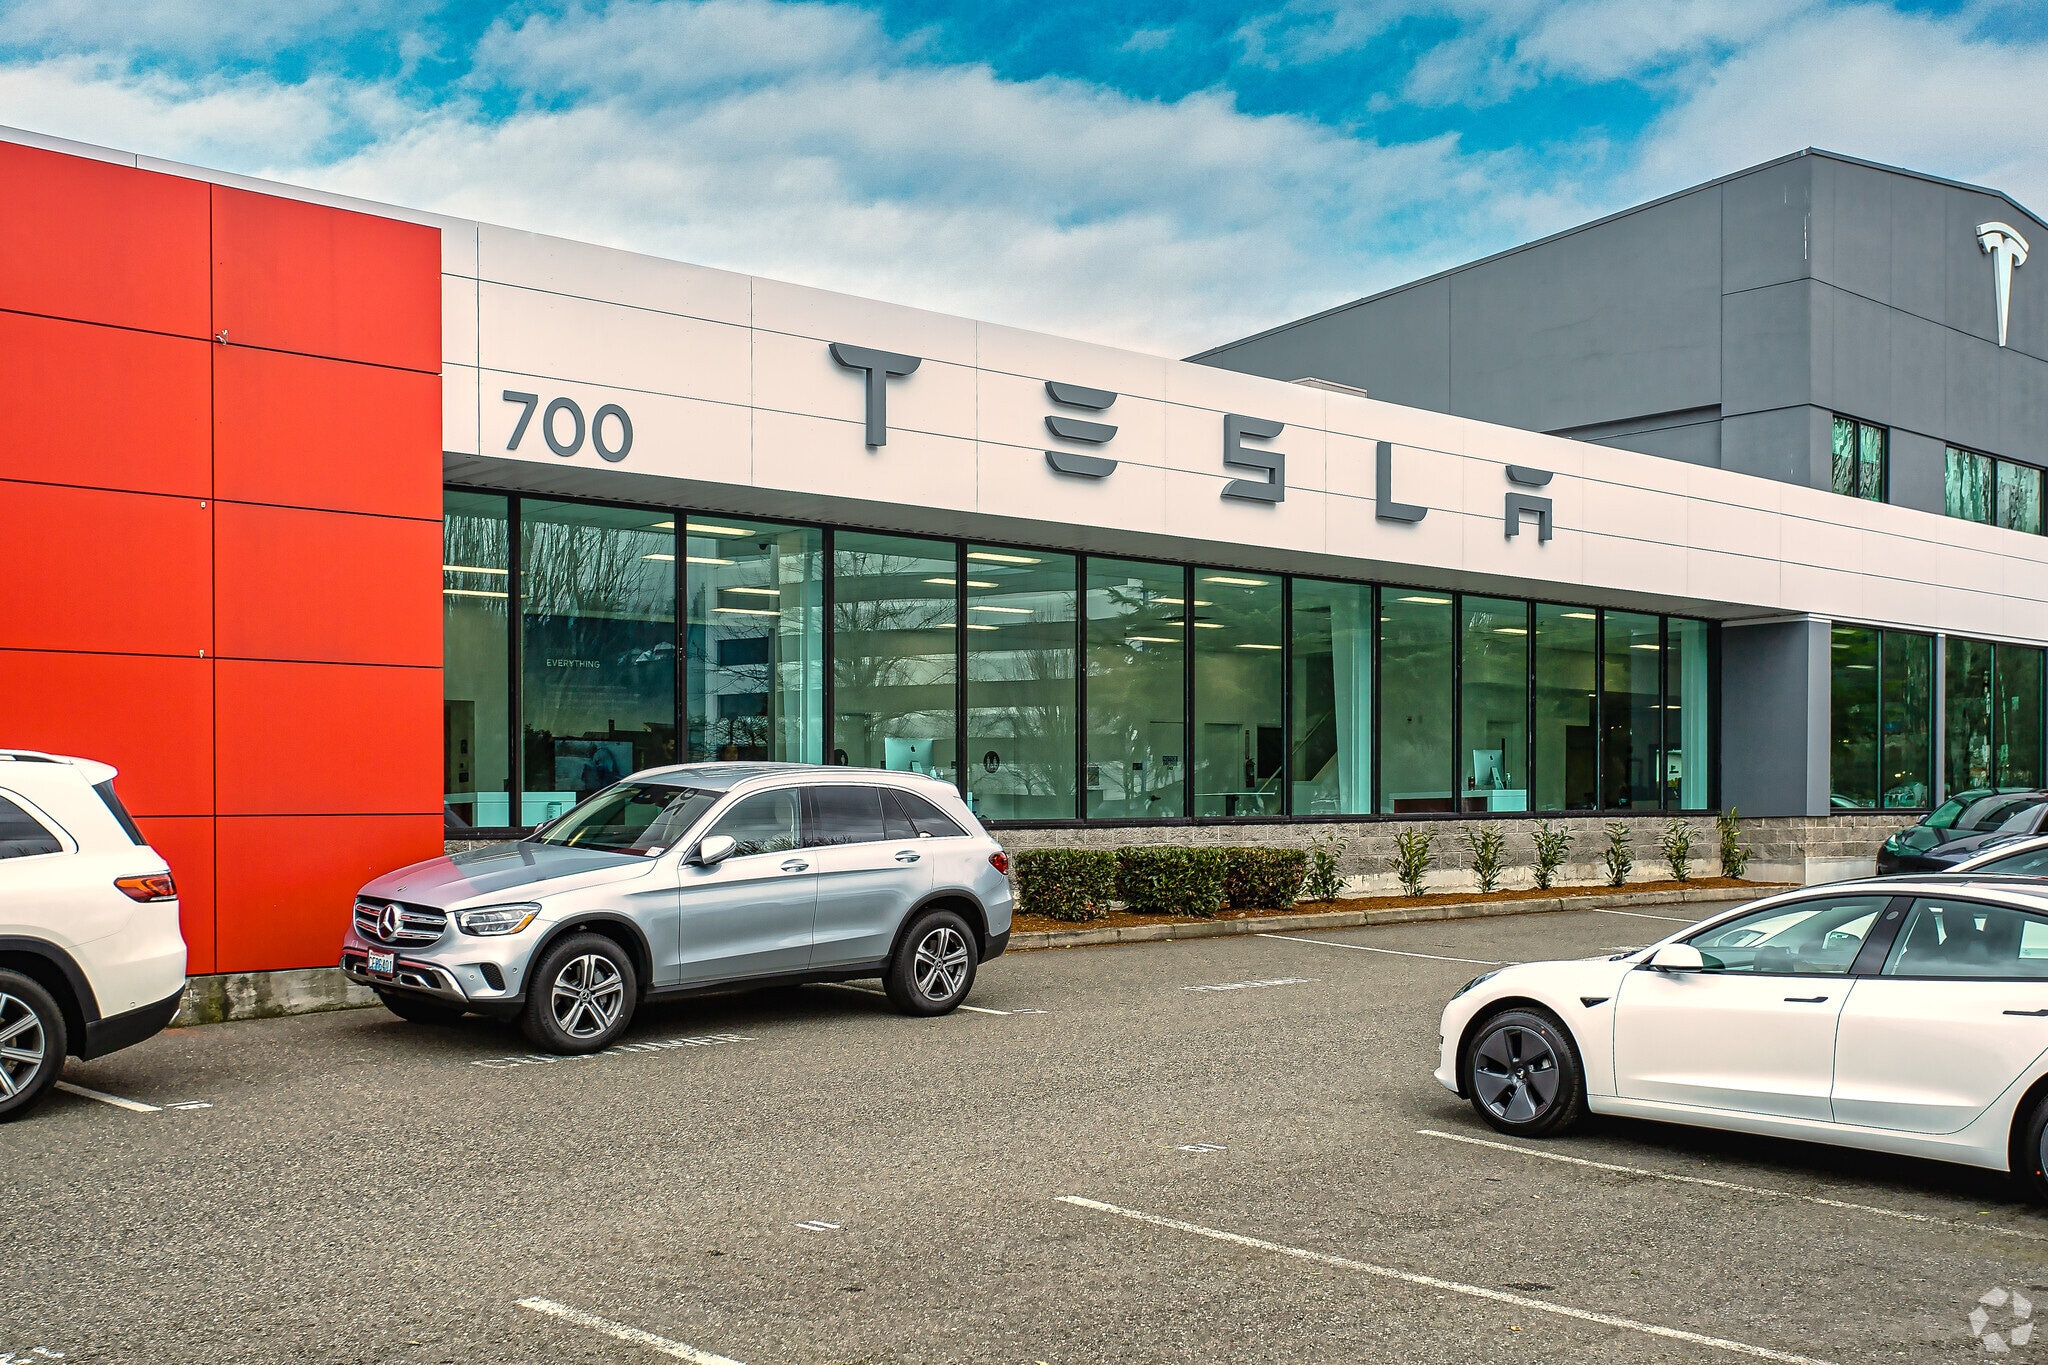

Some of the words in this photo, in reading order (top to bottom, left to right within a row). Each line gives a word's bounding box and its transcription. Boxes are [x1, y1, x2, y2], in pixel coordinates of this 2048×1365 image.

[502, 389, 634, 463] 700
[829, 341, 1554, 543] TESLA
[546, 658, 601, 669] EVERYTHING
